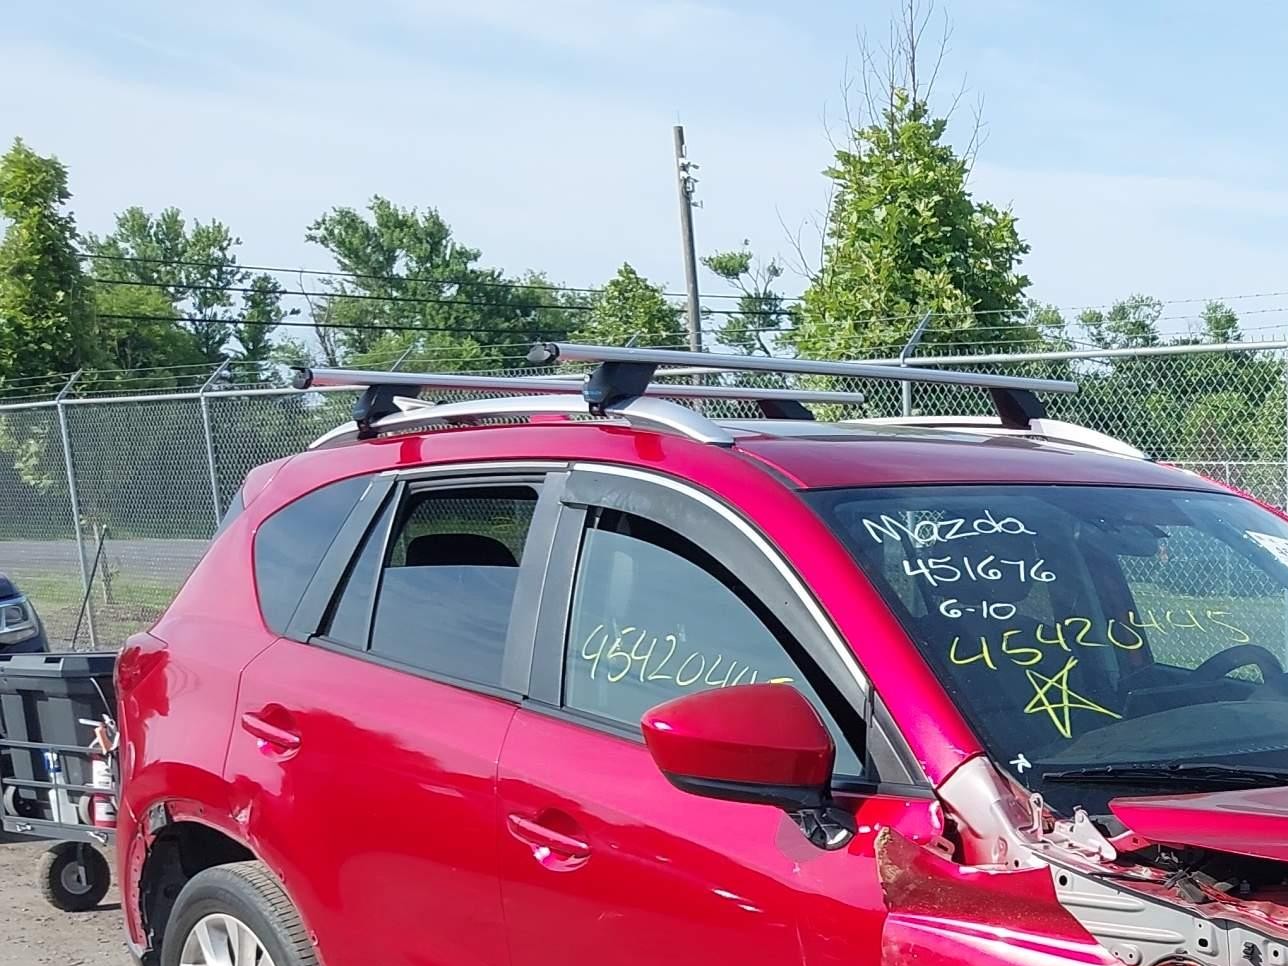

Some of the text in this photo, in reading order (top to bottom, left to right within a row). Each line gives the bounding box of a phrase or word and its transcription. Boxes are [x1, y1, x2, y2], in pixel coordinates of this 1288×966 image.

[861, 508, 1038, 545] Mazda
[901, 554, 1057, 587] 451676
[938, 598, 1017, 620] 6-10
[949, 610, 1250, 671] 45420445
